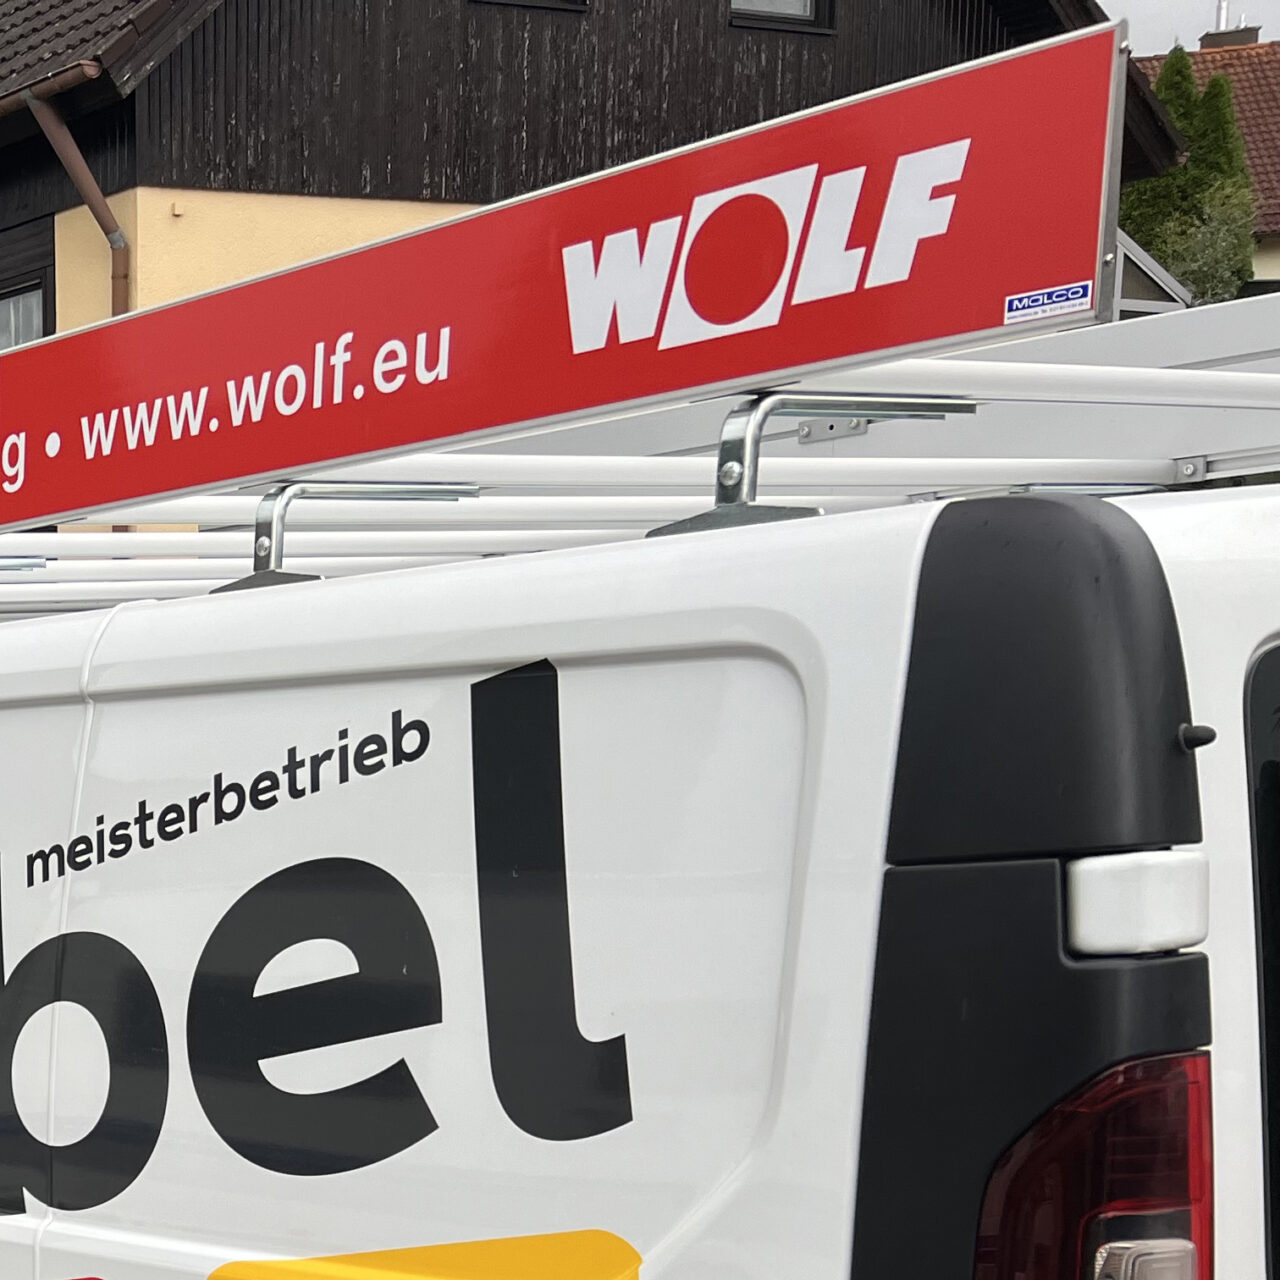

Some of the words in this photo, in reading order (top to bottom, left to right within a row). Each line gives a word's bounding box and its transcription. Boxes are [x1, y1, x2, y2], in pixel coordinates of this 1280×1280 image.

[81, 326, 451, 460] www.wolf.eu
[562, 138, 971, 354] WOLF
[26, 709, 430, 887] meisterbetrieb
